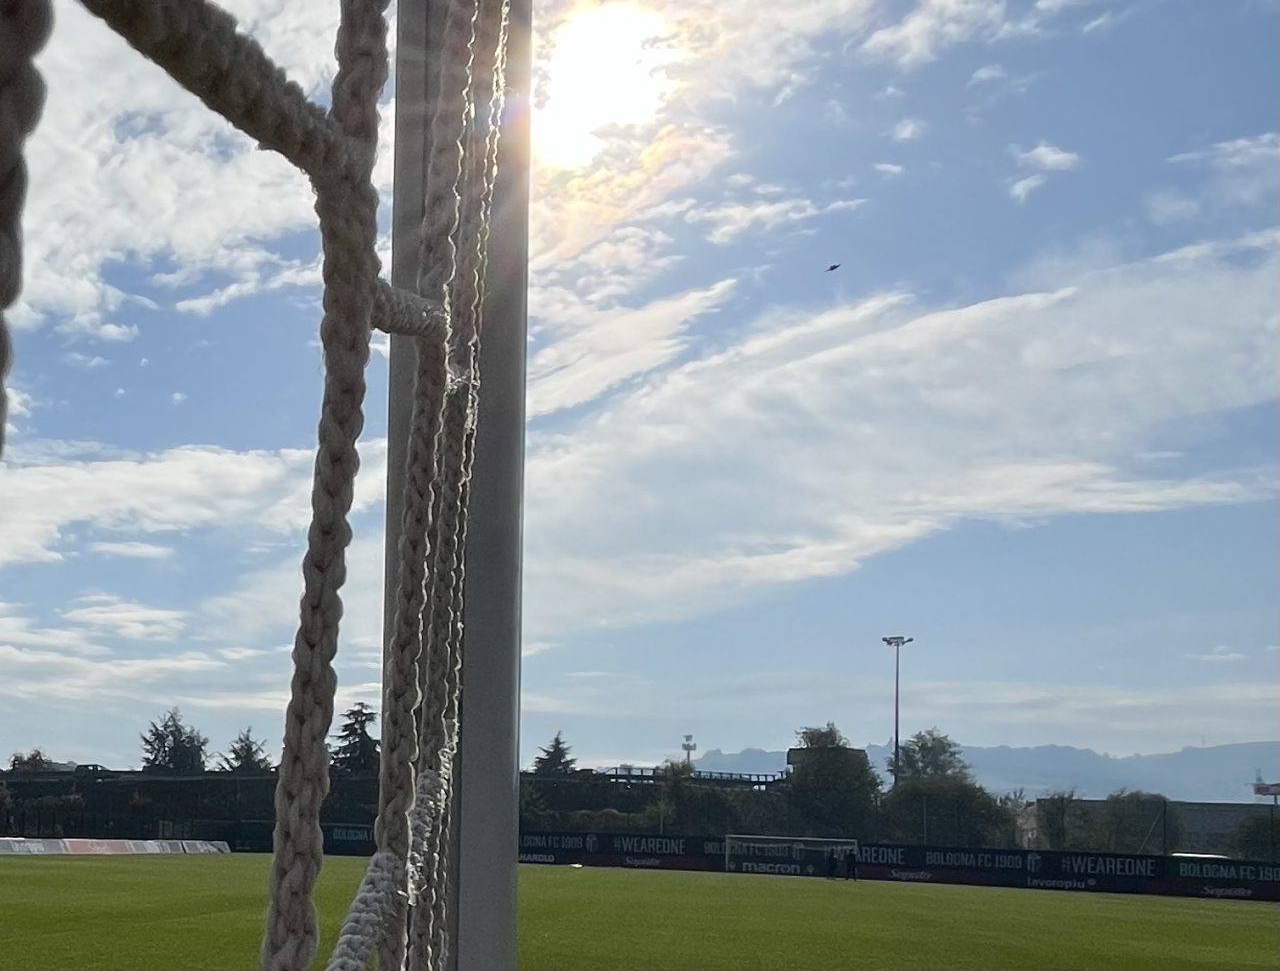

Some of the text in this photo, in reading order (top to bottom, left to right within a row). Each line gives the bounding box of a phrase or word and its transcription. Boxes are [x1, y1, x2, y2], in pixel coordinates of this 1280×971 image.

[614, 836, 687, 854] #WEAREONE
[742, 862, 801, 875] macron
[926, 851, 1023, 869] BOLOGNA FC 1909
[1061, 855, 1156, 877] #WEAREONE
[1180, 862, 1280, 882] BOLOGNA FC 190
